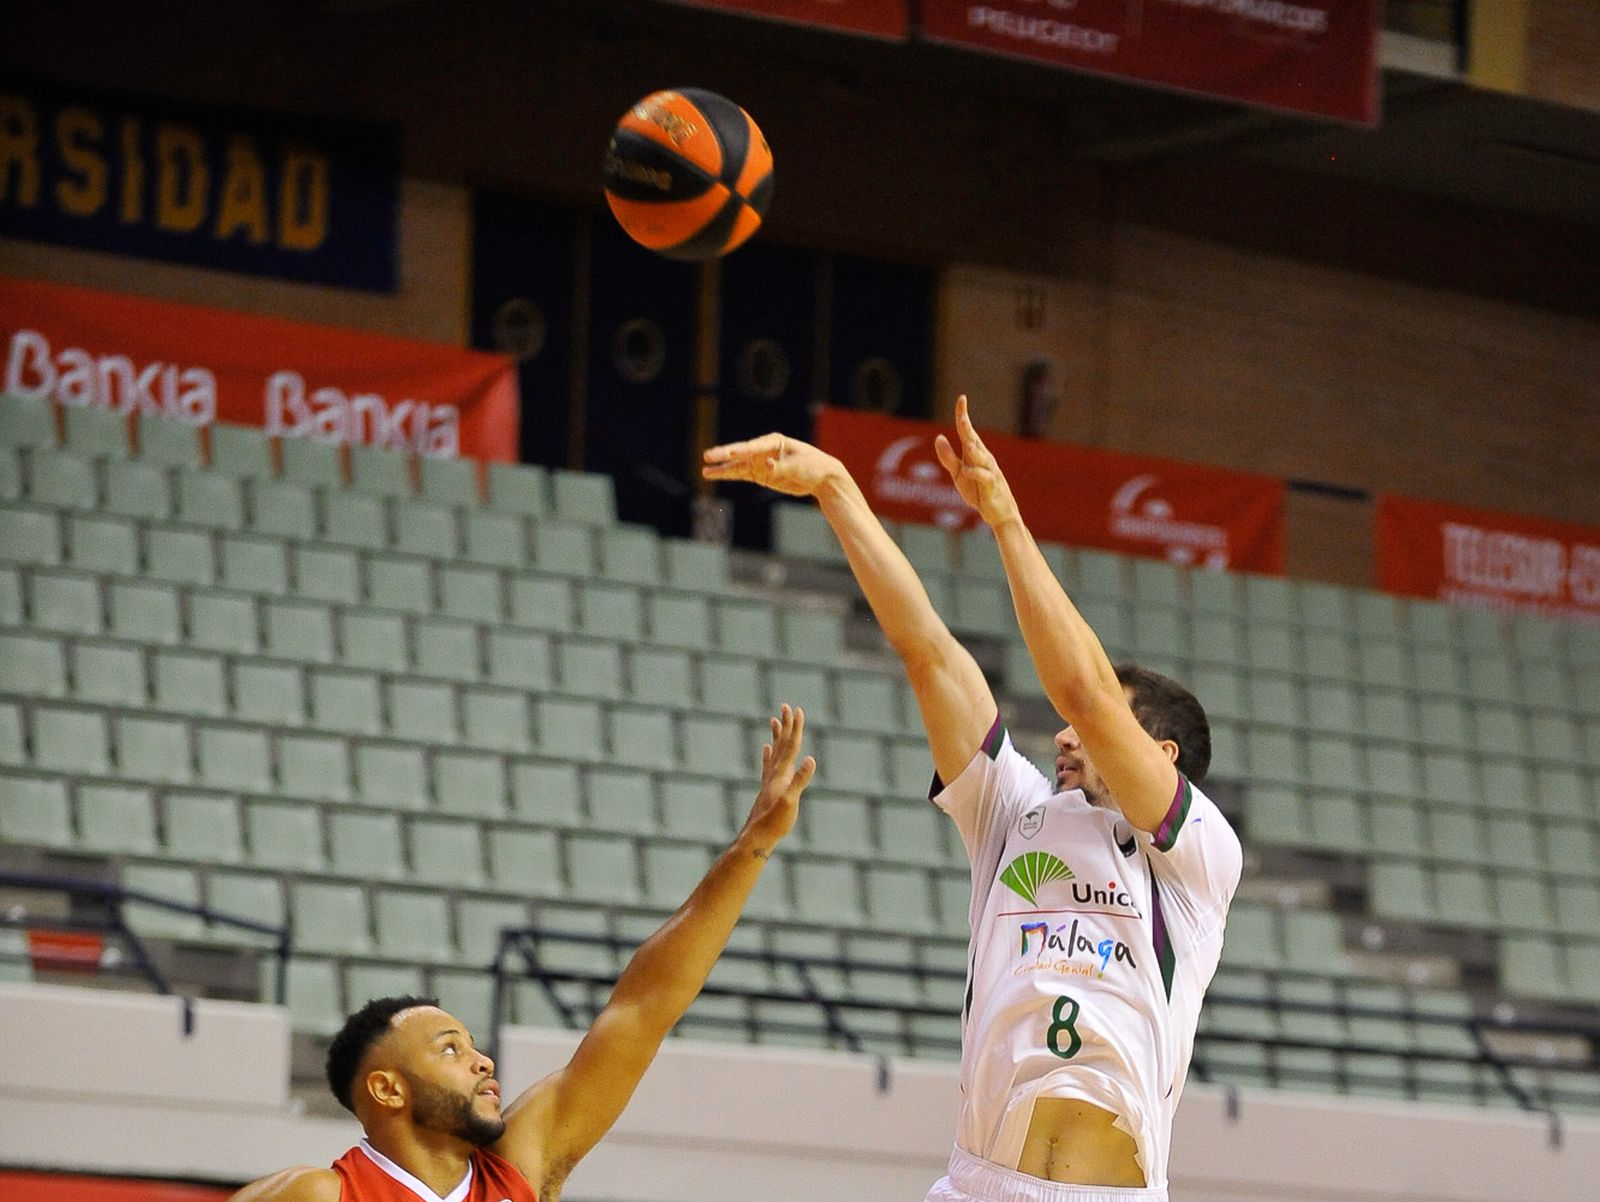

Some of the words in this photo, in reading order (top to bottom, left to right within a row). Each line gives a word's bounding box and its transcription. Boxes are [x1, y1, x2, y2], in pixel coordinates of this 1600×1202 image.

[5, 330, 217, 426] Bankia
[264, 370, 461, 459] Bankia
[1046, 995, 1082, 1059] 8
